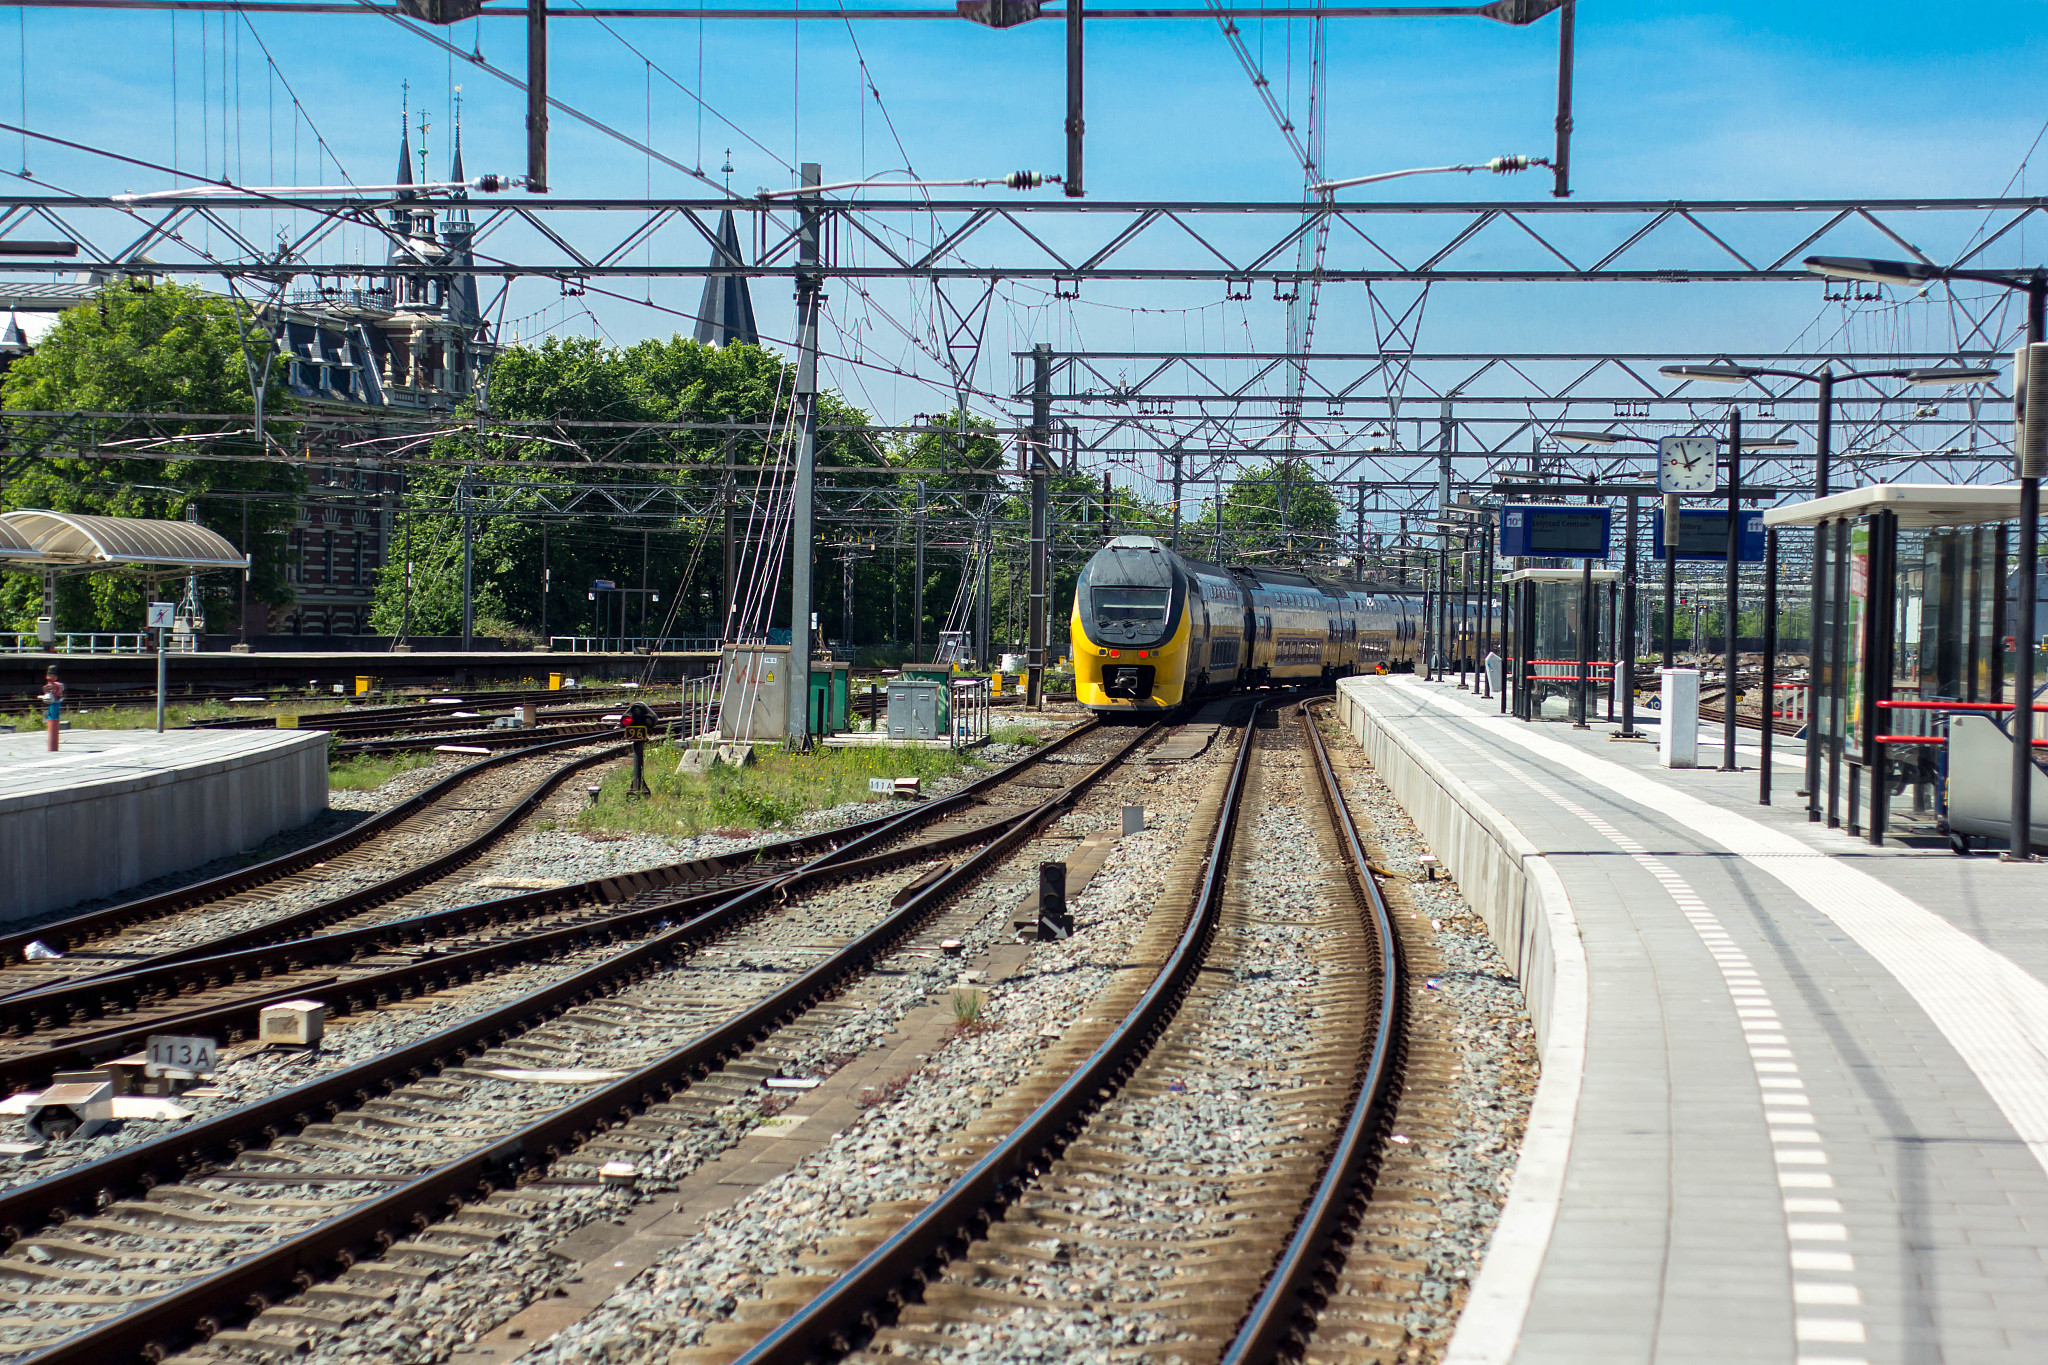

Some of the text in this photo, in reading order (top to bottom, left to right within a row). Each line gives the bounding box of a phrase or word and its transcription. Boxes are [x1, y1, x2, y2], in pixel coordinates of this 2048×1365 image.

[1532, 519, 1591, 528] Lelystad Centrum
[1650, 701, 1660, 710] 10
[629, 728, 643, 738] 96
[870, 781, 892, 791] 111A
[152, 1044, 210, 1067] 113A
